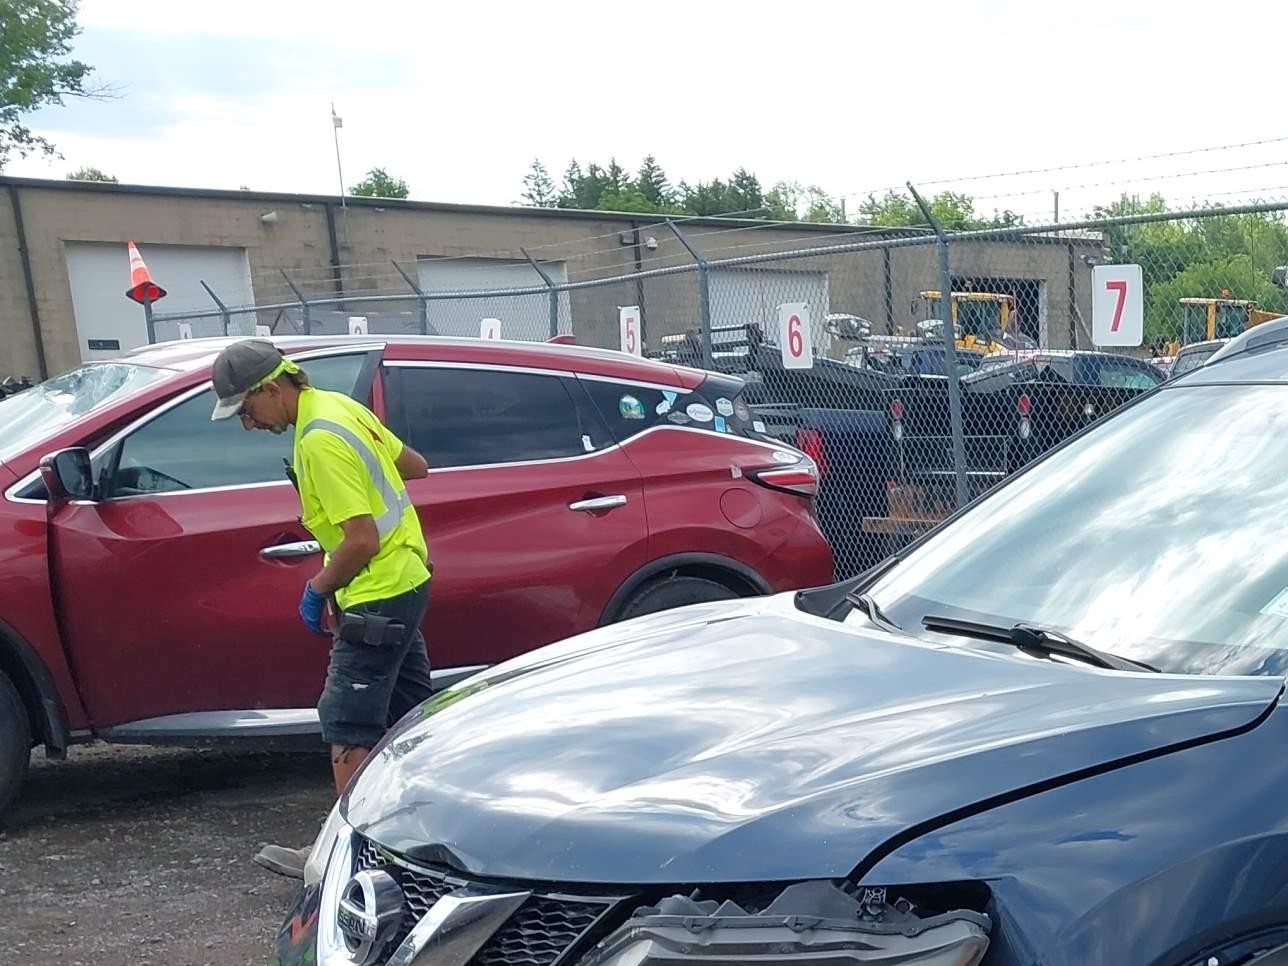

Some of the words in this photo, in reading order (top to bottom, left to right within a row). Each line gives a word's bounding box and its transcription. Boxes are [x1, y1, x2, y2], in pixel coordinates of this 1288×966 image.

[1106, 281, 1127, 332] 7
[624, 317, 636, 354] 5
[787, 314, 803, 358] 6
